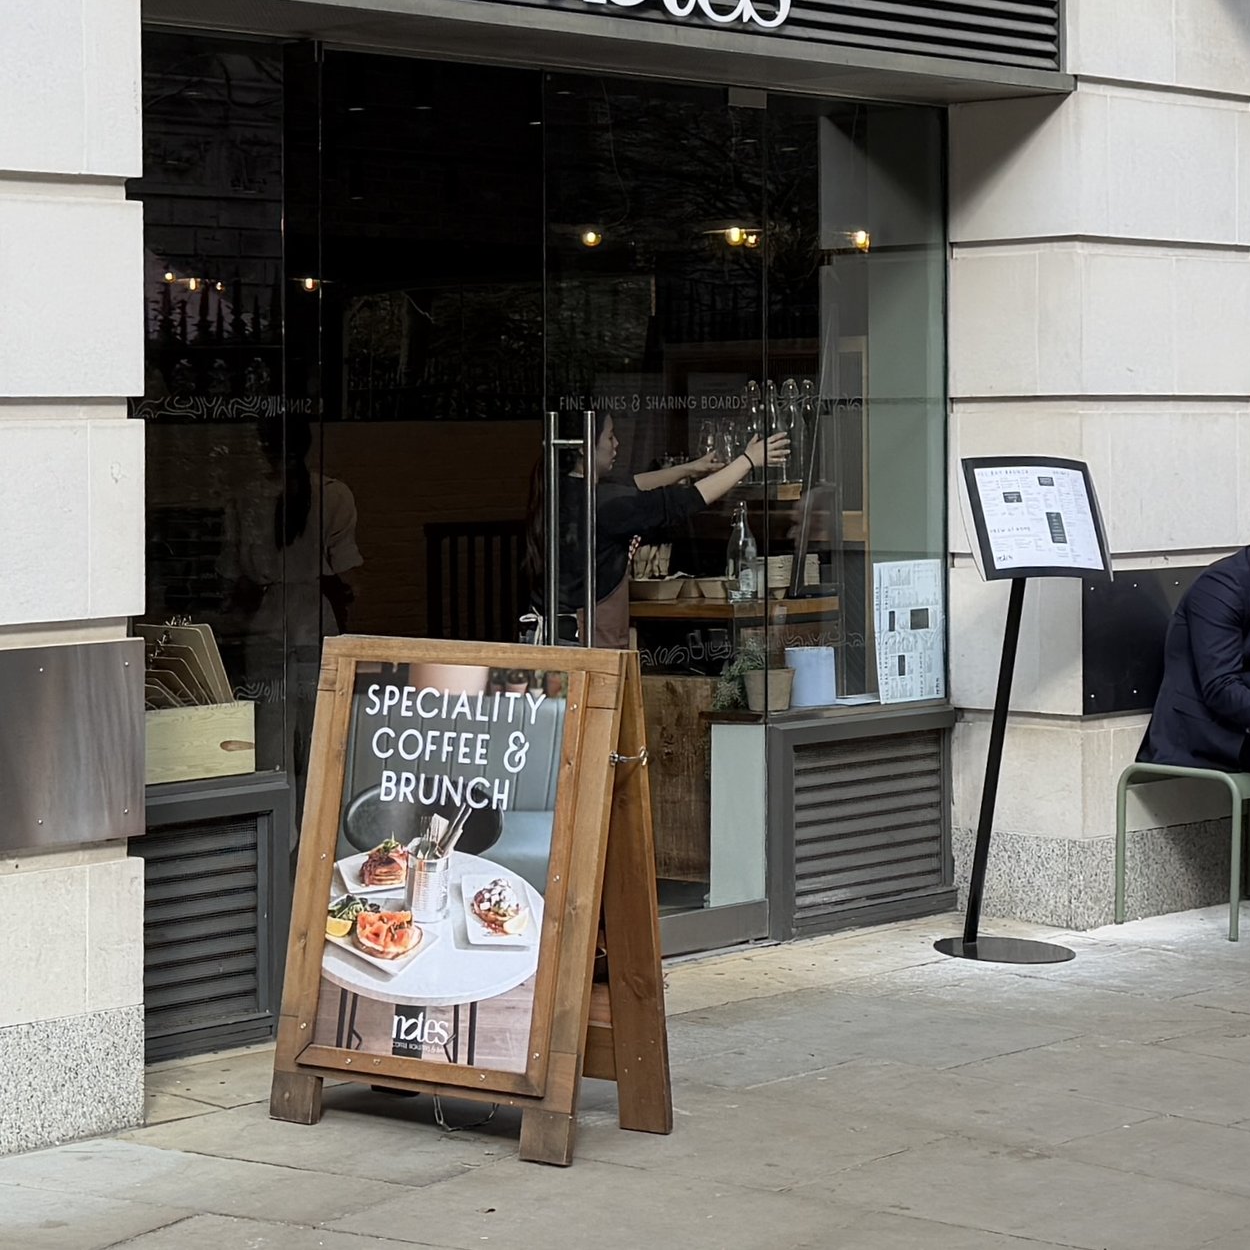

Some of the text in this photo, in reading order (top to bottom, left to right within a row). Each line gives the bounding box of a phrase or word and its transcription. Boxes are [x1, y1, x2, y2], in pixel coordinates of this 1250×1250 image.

[559, 394, 748, 412] FINE WINES & SHARING BOARDS
[365, 683, 546, 725] SPECIALITY
[372, 727, 530, 774] COFFEE &
[380, 770, 511, 811] BRUNCH
[392, 1011, 449, 1045] notes
